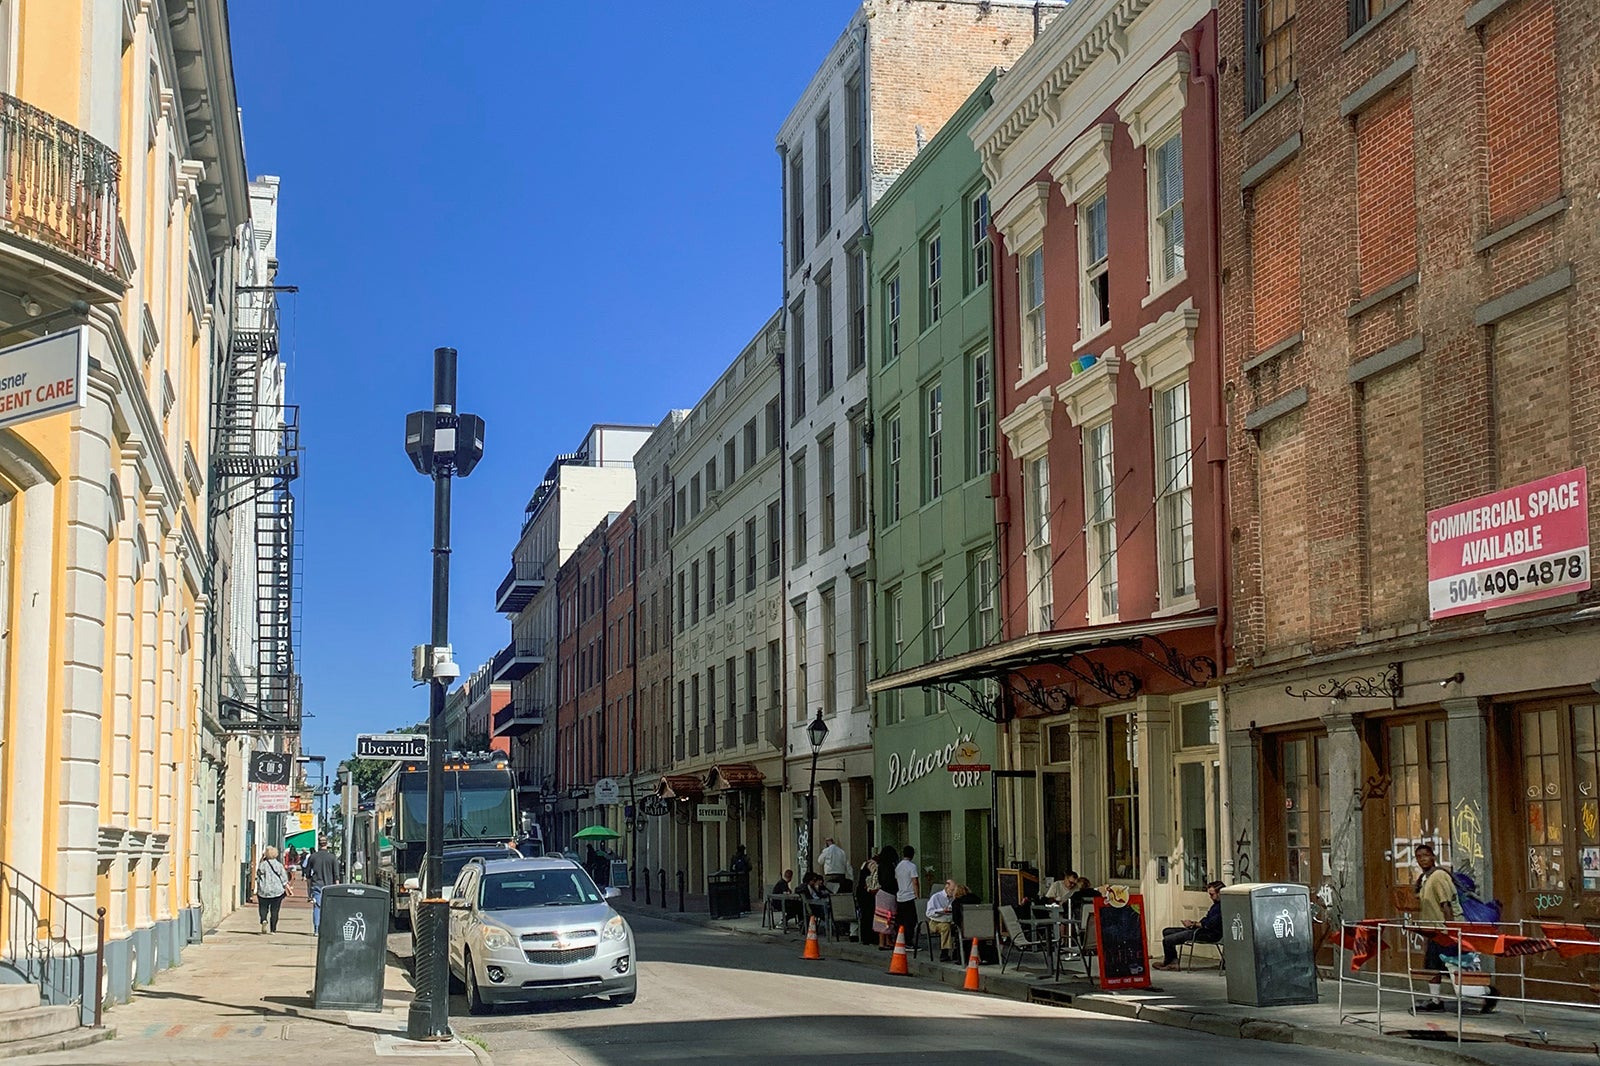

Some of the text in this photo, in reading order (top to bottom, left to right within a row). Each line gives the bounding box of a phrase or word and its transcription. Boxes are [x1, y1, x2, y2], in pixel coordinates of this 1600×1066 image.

[36, 378, 74, 402] CARE
[1429, 480, 1580, 544] COMMERCIAL SPACE
[1461, 524, 1543, 567] AVAILABLE
[360, 741, 423, 755] Iberville
[952, 770, 983, 787] CORP.
